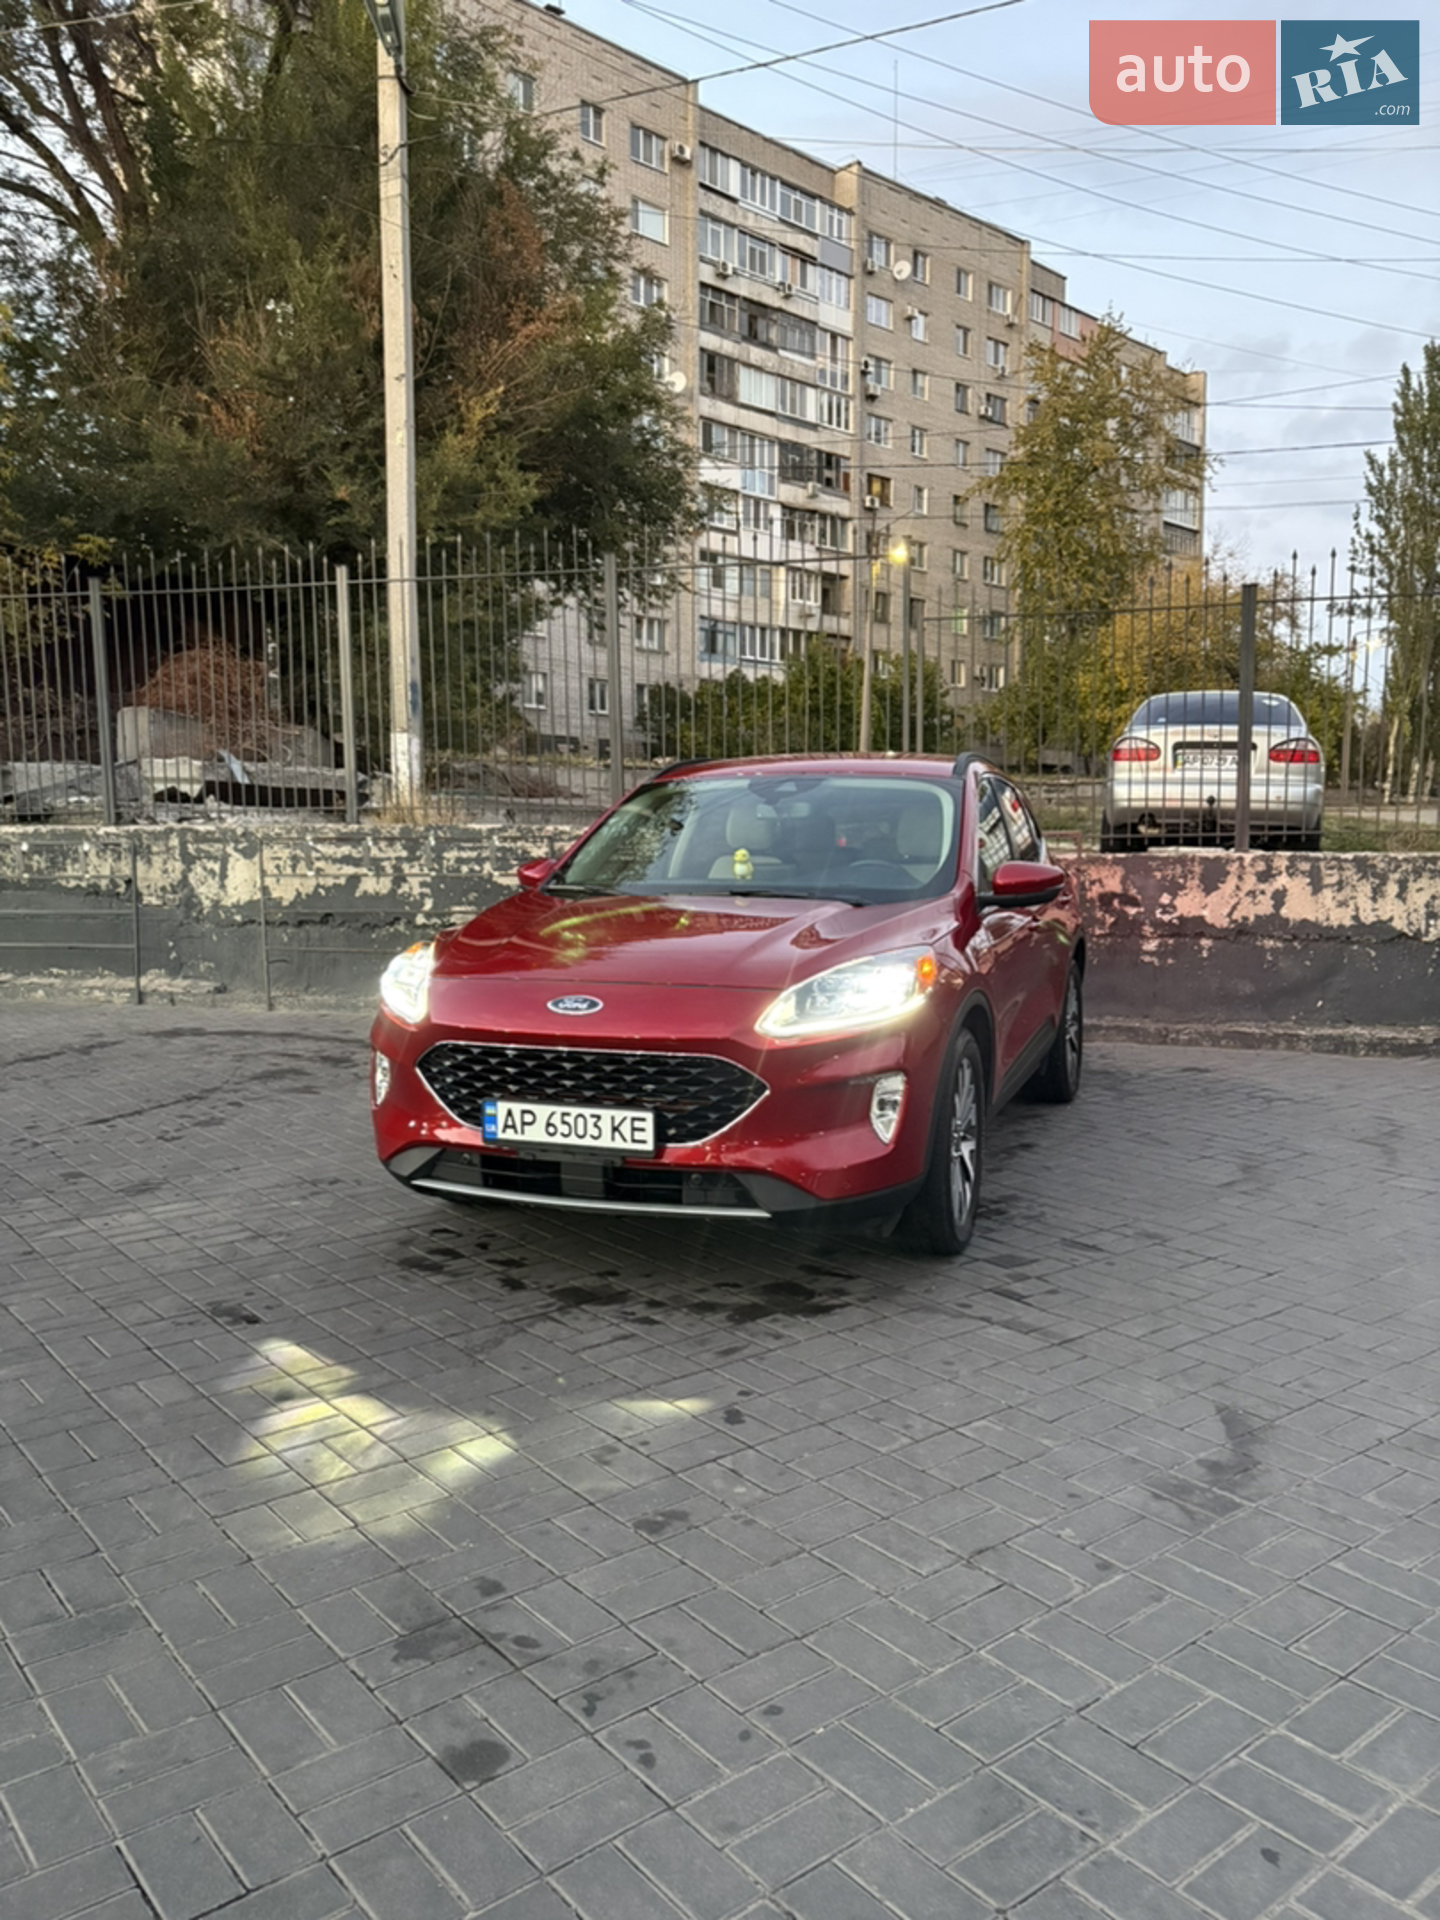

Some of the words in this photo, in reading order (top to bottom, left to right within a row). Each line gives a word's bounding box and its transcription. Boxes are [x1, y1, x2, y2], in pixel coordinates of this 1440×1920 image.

[502, 1108, 537, 1135] AP
[545, 1111, 602, 1140] 6503
[611, 1115, 647, 1144] KE
